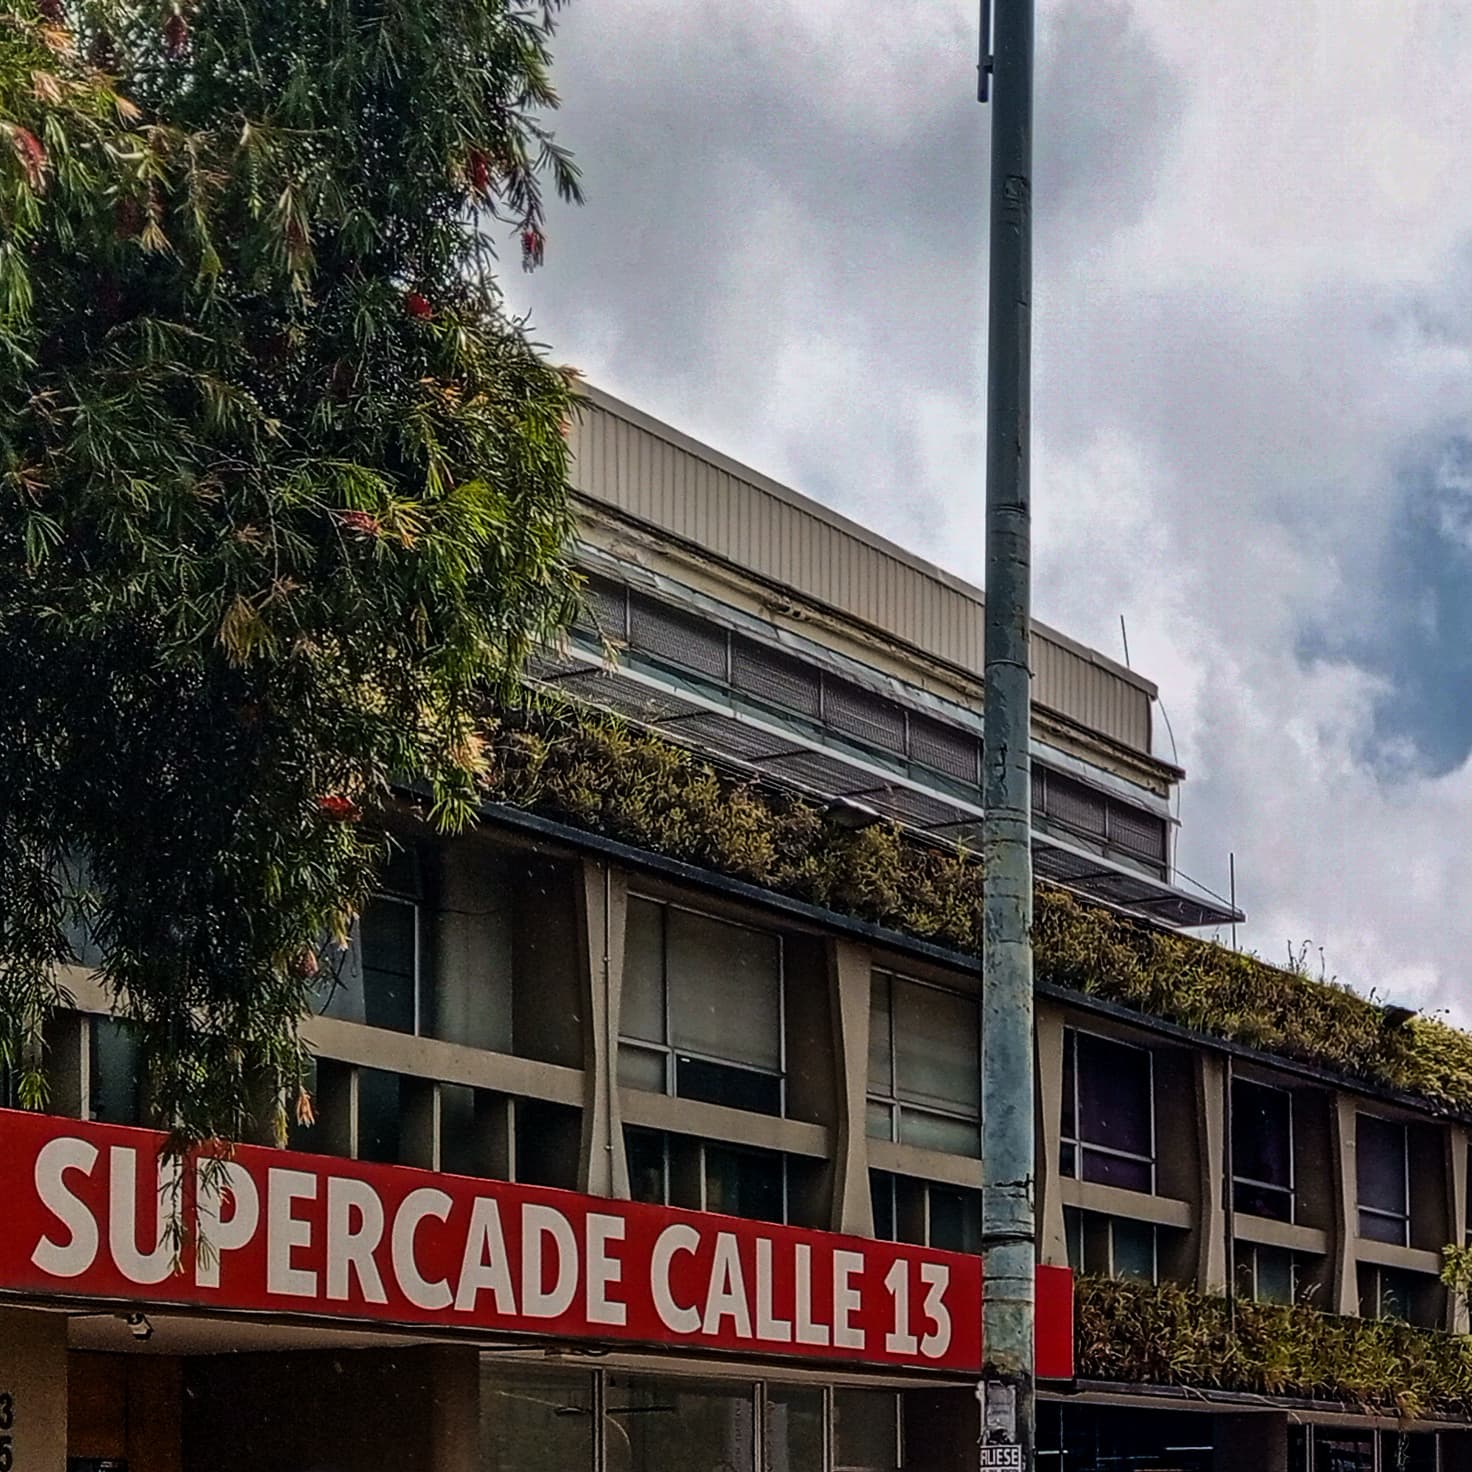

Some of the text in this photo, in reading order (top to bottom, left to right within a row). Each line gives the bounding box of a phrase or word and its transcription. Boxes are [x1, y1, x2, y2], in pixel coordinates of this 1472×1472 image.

[31, 1136, 951, 1358] SUPERCADE CALLE 13
